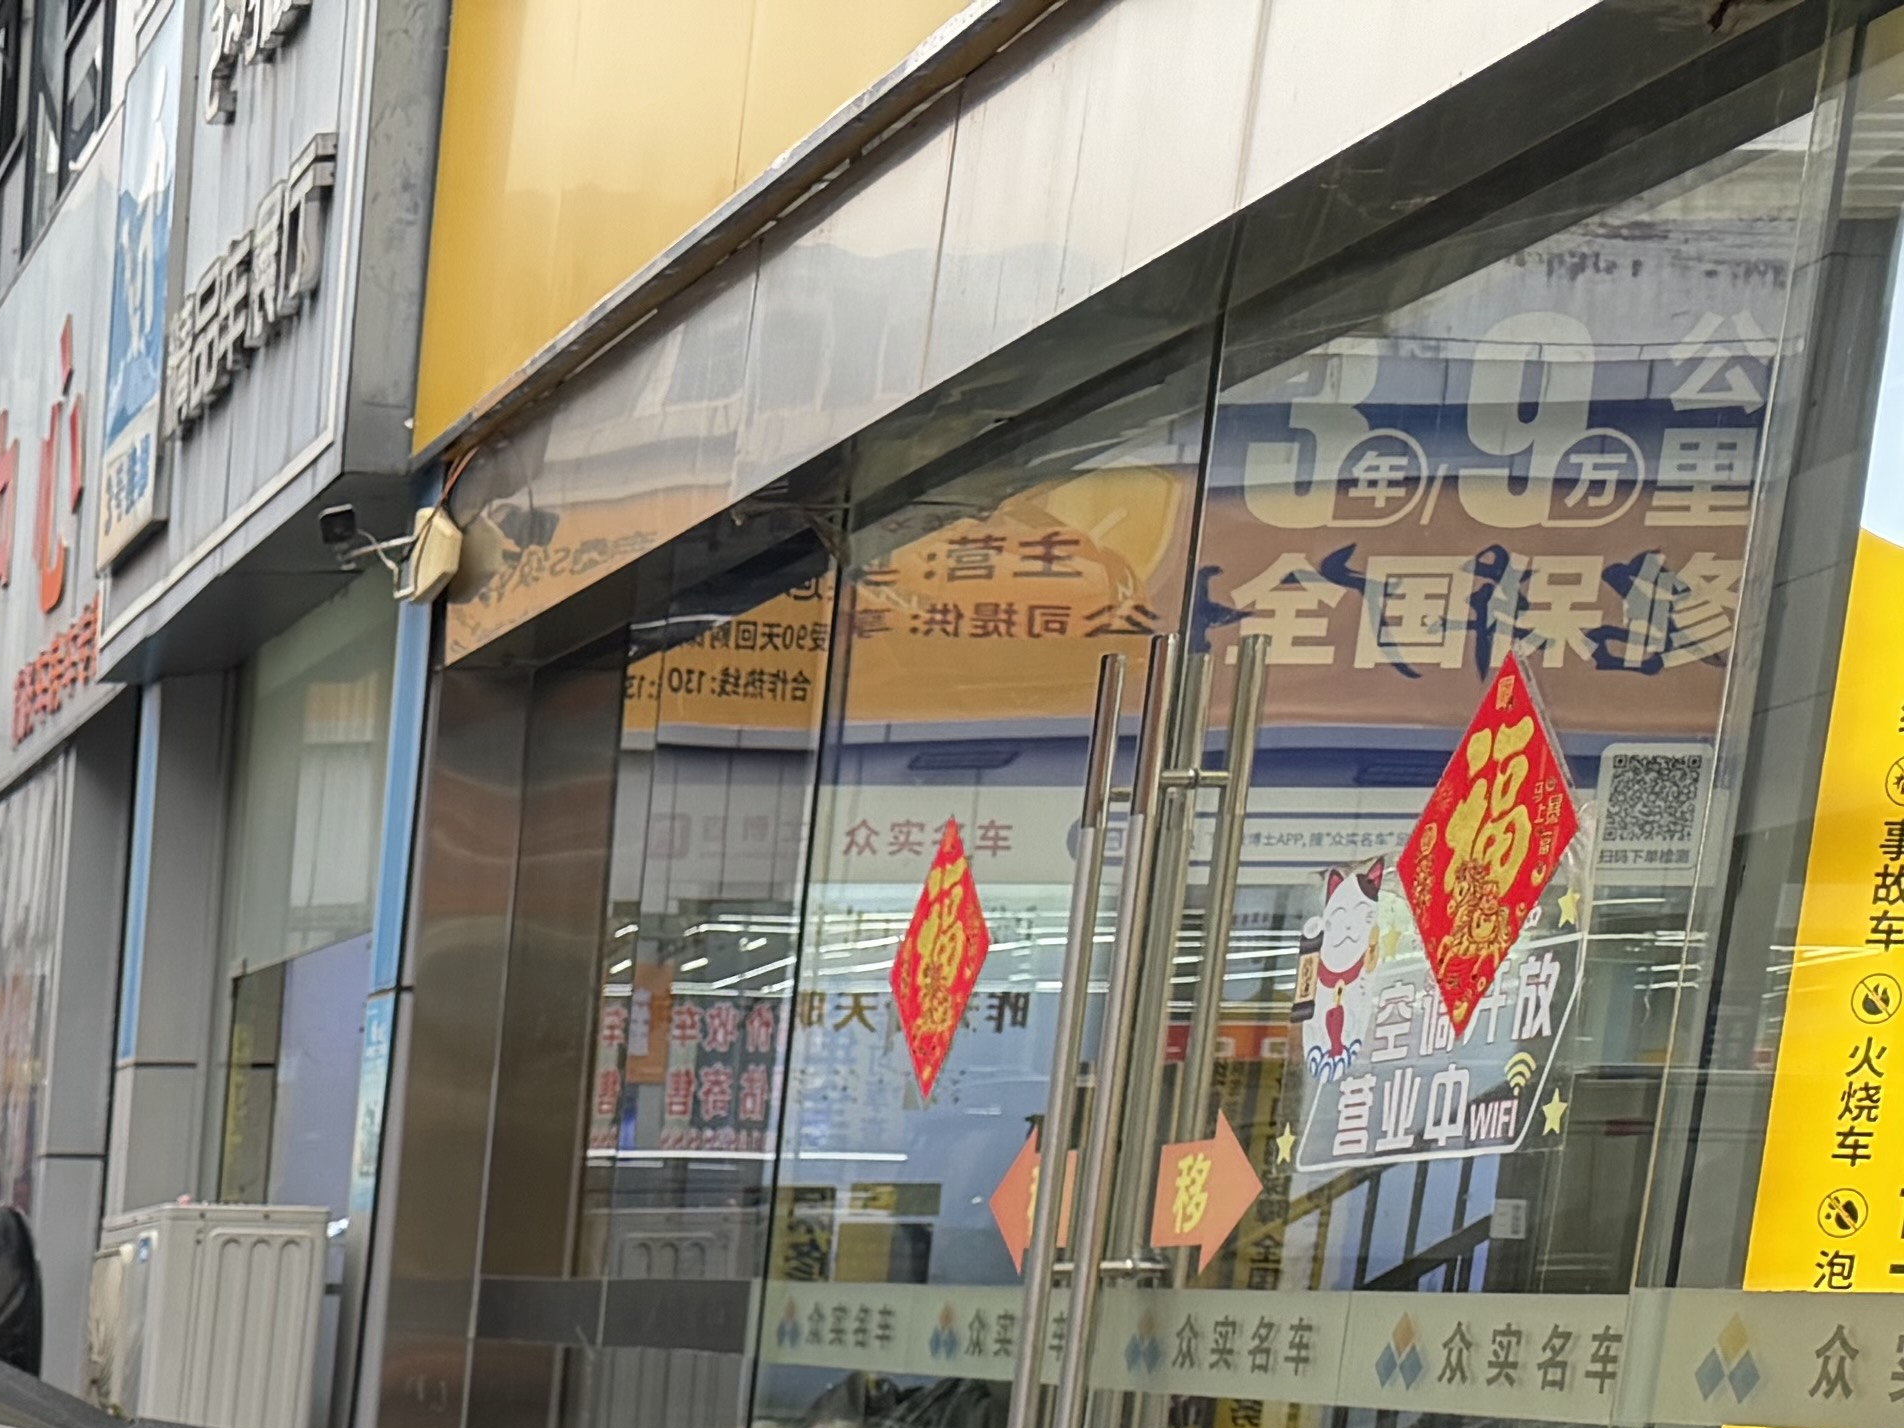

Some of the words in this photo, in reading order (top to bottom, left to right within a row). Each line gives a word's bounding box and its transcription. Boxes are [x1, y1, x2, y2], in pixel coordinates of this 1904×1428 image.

[1331, 1063, 1471, 1157] 营业中
[1469, 1099, 1519, 1142] WIFI
[1831, 1036, 1888, 1168] 火烧车
[1172, 1152, 1213, 1235] 移
[964, 1308, 1067, 1358] 众实车
[1172, 1314, 1313, 1376] 众实名车
[1437, 1321, 1624, 1395] 众实名车
